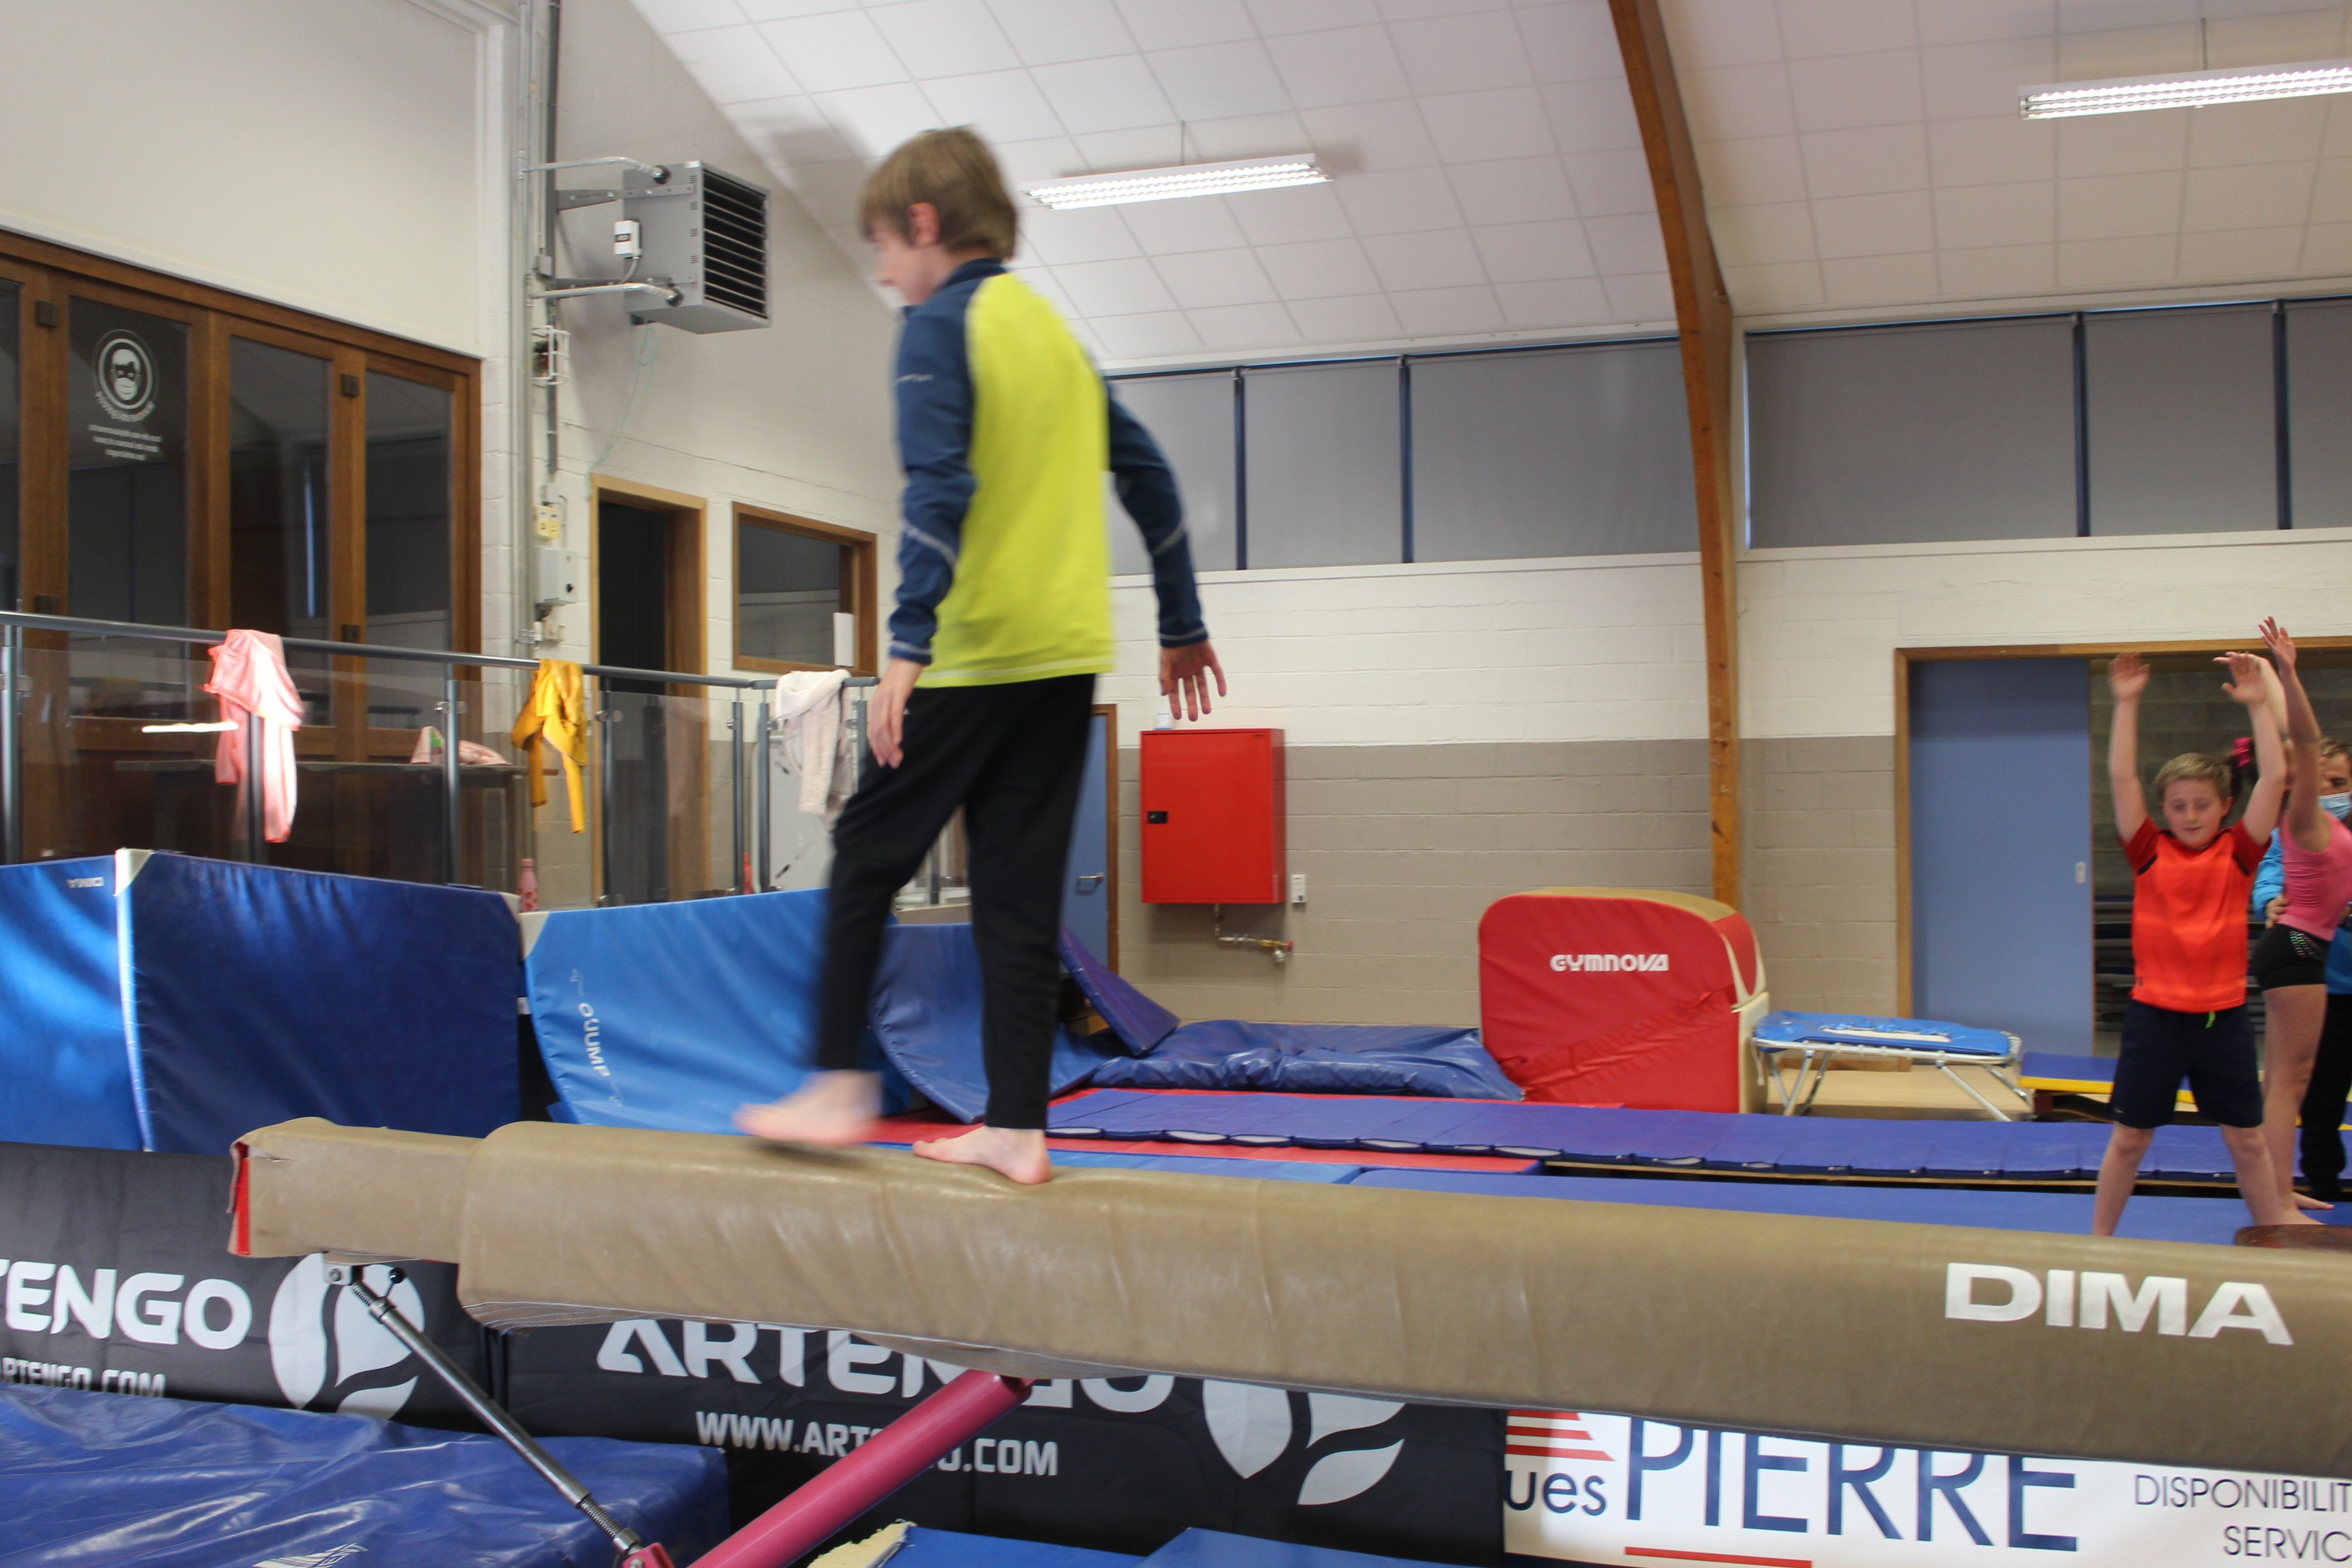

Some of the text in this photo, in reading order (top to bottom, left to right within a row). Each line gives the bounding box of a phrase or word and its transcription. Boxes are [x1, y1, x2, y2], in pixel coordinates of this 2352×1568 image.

[1550, 954, 1669, 972] GYMNOVA
[0, 1259, 253, 1350] ENGO
[1945, 1262, 2294, 1346] DIMA
[1625, 1417, 2078, 1552] PIERRE
[2134, 1474, 2352, 1513] DISPONIBILIT
